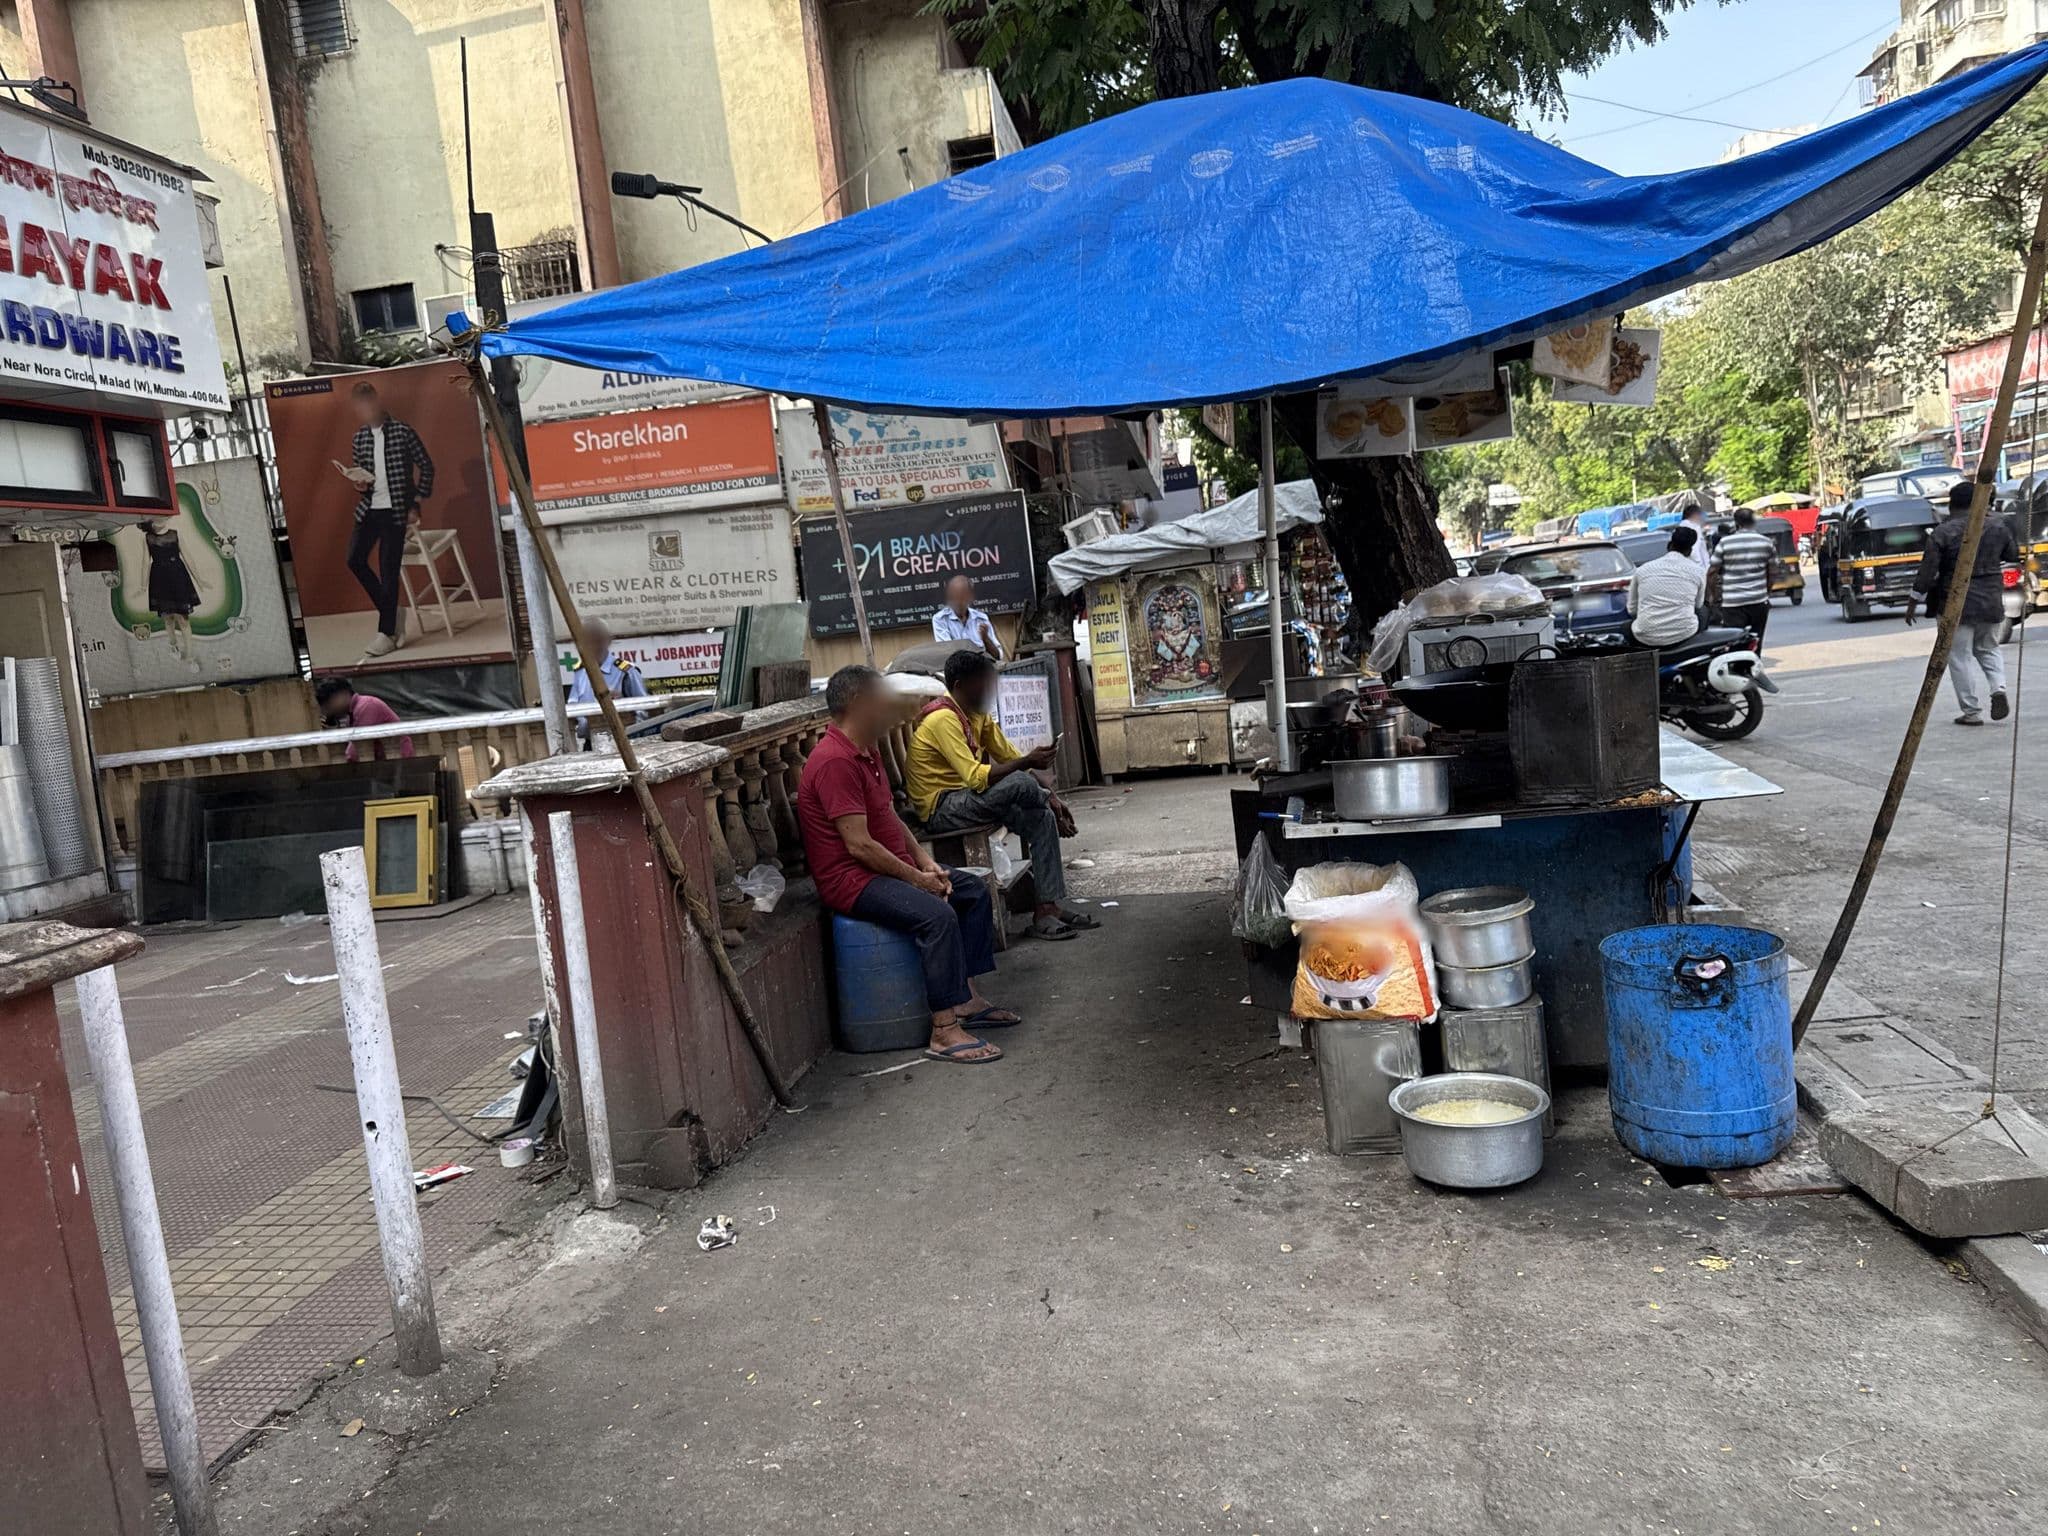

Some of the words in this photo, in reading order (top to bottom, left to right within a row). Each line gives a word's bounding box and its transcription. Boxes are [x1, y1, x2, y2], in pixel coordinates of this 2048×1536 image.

[0, 299, 184, 373] RDWARE
[4, 358, 30, 372] Near
[35, 364, 61, 378] Nora
[100, 375, 130, 389] Malad
[154, 384, 188, 398] Mumbai
[573, 422, 688, 452] Sharekhan
[811, 445, 884, 460] FEVER
[889, 437, 968, 453] EXPRESS
[699, 464, 734, 473] EDUCATION
[863, 461, 901, 471] EXPRESS
[902, 458, 950, 468] LOGISTICS
[952, 452, 997, 462] SERVICES
[840, 478, 857, 489] DIA
[859, 476, 873, 487] TO
[876, 474, 898, 485] USA
[901, 468, 962, 484] SPECIALIST
[556, 498, 584, 508] WHAT
[585, 495, 608, 505] FULL
[609, 490, 647, 503] SERVICE
[648, 485, 689, 498] BROKING
[690, 482, 710, 492] CAN
[711, 481, 725, 490] DO
[726, 478, 745, 488] FOR
[746, 476, 766, 486] YOU
[854, 487, 897, 502] FedEx
[908, 490, 924, 501] ups
[931, 479, 993, 495] aramex
[890, 531, 961, 557] BRAND
[893, 545, 1000, 577] CREATION
[613, 577, 665, 591] WEAR
[670, 575, 682, 588] &
[687, 569, 778, 587] CLOTHERS
[578, 596, 623, 608] Specialist
[640, 593, 681, 605] Designer
[684, 591, 707, 601] Suits
[709, 590, 716, 599] &
[719, 587, 763, 599] Sherwani
[1092, 611, 1119, 625] ESTATE
[1096, 630, 1120, 645] AGENT
[641, 650, 652, 662] L.
[1005, 714, 1014, 725] FOR
[1016, 713, 1024, 723] OUT
